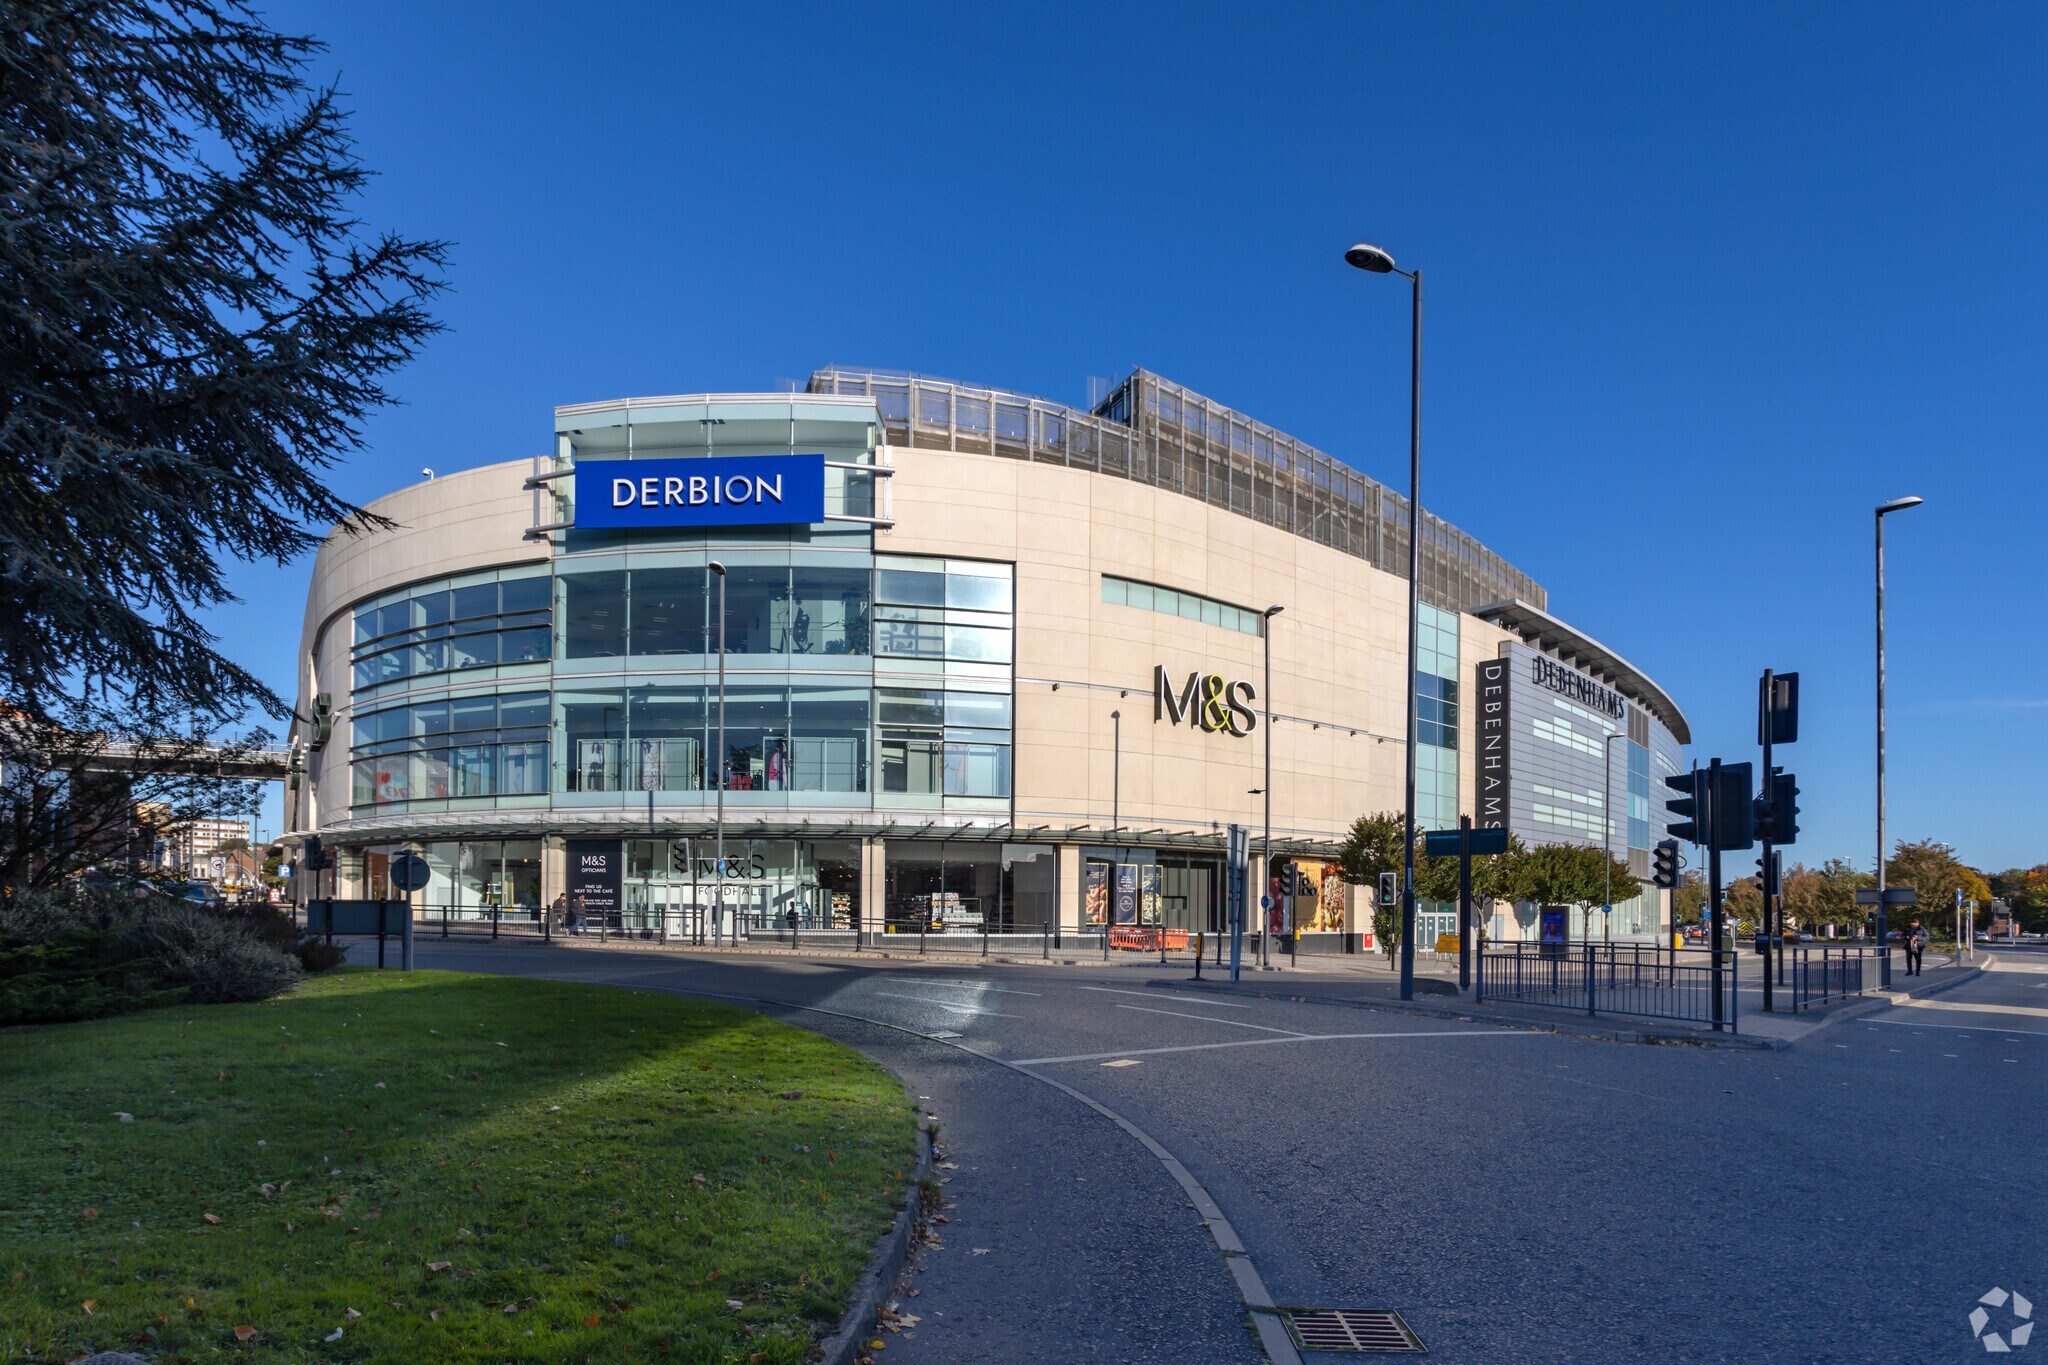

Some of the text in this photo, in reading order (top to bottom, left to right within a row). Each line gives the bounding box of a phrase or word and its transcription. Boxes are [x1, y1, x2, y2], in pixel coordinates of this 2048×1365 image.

[612, 474, 782, 508] DERBION
[1154, 664, 1257, 737] M&S
[1532, 655, 1625, 720] DEBENHAMS
[1485, 665, 1501, 828] DEBENHAMS
[281, 867, 290, 875] P
[581, 855, 606, 866] M&S
